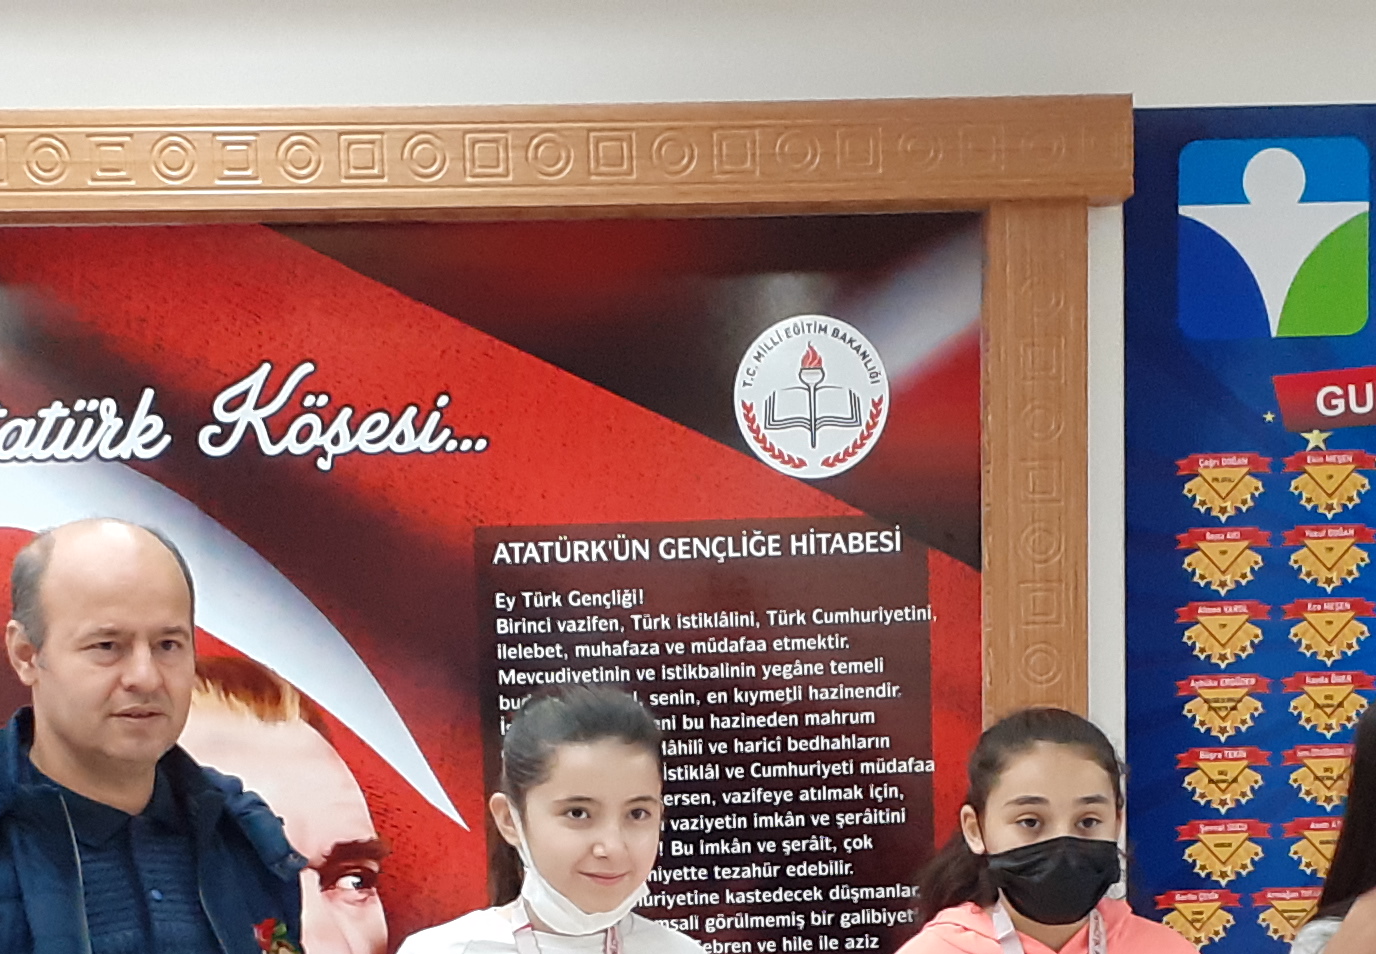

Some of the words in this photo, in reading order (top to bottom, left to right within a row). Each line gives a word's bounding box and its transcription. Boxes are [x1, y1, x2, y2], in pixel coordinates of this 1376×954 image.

[742, 366, 760, 389] T.C.
[753, 328, 784, 364] MİLLİ
[784, 320, 829, 340] EĞİTİM
[830, 326, 882, 385] BAKANLIĞI
[198, 362, 487, 470] Köşesi...
[492, 533, 649, 564] ATATÜRK'ÜN
[658, 528, 781, 562] GENÇLİĞE
[790, 524, 900, 555] HİTABESİ
[494, 591, 515, 612] Ey
[520, 590, 562, 608] Türk
[567, 588, 643, 609] Gençliği!
[496, 616, 551, 634] Birinci
[556, 615, 625, 633] vazifen,
[630, 612, 671, 631] Türk
[676, 609, 760, 629] istiklâlini,
[765, 608, 807, 626] Türk
[812, 604, 937, 625] Cumhuriyetini,
[496, 642, 568, 660] ilelebet,
[574, 639, 660, 657] muhafaza
[664, 642, 685, 654] ve
[690, 635, 767, 653] müdafaa
[772, 632, 849, 651] etmektir.
[635, 668, 655, 681] ve
[661, 661, 756, 680] istikbalinin
[761, 658, 824, 680] yegâne
[829, 656, 884, 674] temeli
[649, 688, 700, 705] senin,
[706, 690, 728, 704] en
[733, 684, 802, 706] kıymetli
[808, 681, 901, 700] hazinendir.
[682, 714, 704, 730] bu
[709, 711, 798, 729] hazineden
[804, 708, 875, 726] mahrum
[707, 741, 727, 754] ve
[733, 734, 781, 753] haricî
[786, 733, 890, 752] bedhahların
[724, 765, 744, 779] ve
[749, 758, 853, 779] Cumhuriyeti
[859, 756, 935, 774] müdafaa
[721, 786, 793, 806] vazifeye
[798, 783, 863, 801] atılmak
[868, 782, 903, 803] için,
[669, 813, 747, 833] vaziyetin
[752, 810, 805, 828] imkân
[809, 813, 830, 826] ve
[835, 807, 905, 829] şerâitini
[671, 839, 694, 856] Bu
[699, 836, 752, 854] imkân
[756, 840, 777, 853] ve
[781, 834, 837, 855] şerâit,
[843, 833, 873, 854] çok
[712, 861, 780, 880] tezahür
[784, 859, 853, 877] edebilir.
[725, 885, 823, 904] kastedecek
[704, 910, 805, 934] görülmemiş
[810, 910, 834, 925] bir
[755, 939, 776, 952] ve
[781, 935, 812, 952] hile
[817, 934, 838, 950] ile
[843, 933, 879, 949] aziz
